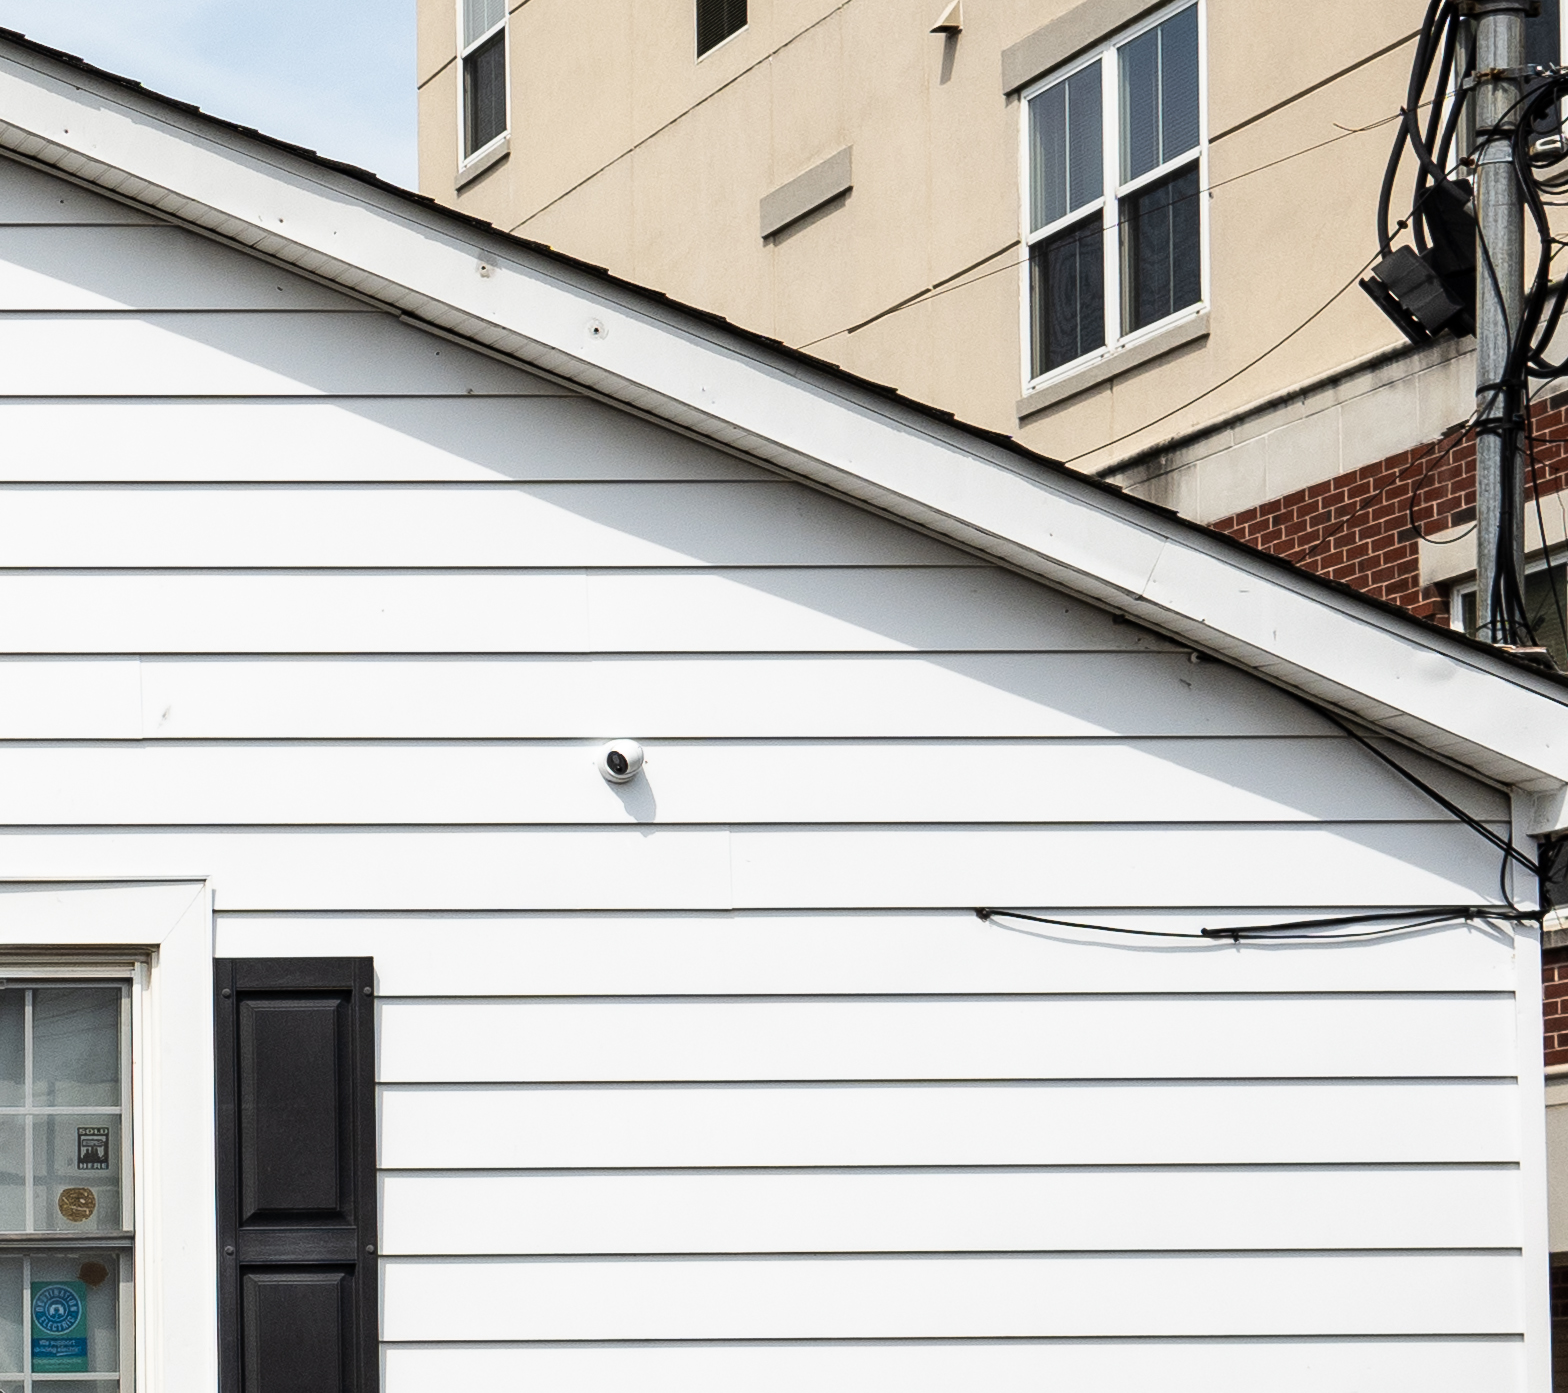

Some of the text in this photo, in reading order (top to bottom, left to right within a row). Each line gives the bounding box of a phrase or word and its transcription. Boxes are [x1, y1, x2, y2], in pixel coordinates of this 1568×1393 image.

[78, 1127, 109, 1135] SOLD
[79, 1162, 109, 1170] HERE
[38, 1314, 76, 1332] ELECTRIC
